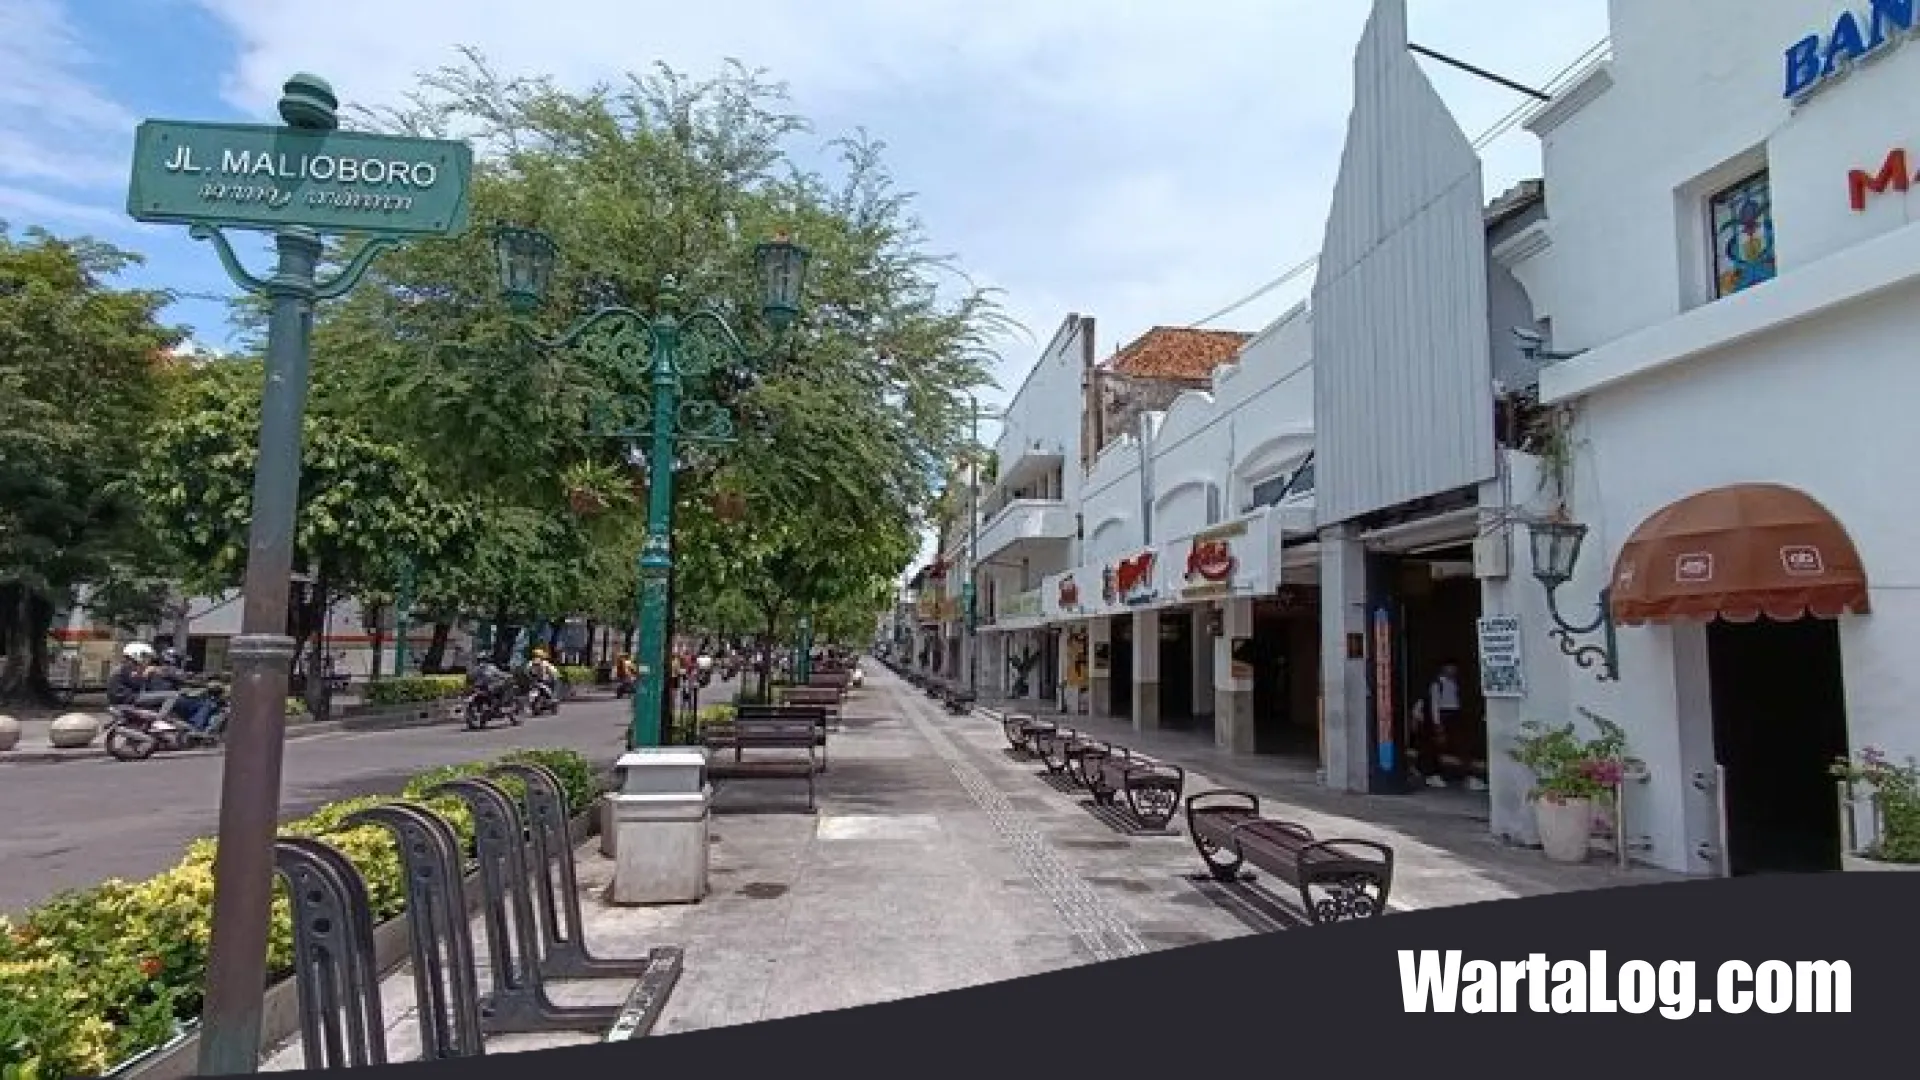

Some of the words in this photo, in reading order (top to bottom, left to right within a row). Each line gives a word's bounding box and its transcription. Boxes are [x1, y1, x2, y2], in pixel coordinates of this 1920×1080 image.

[164, 145, 212, 173] JL.
[221, 150, 437, 188] MALIOBORO
[1849, 148, 1920, 212] M
